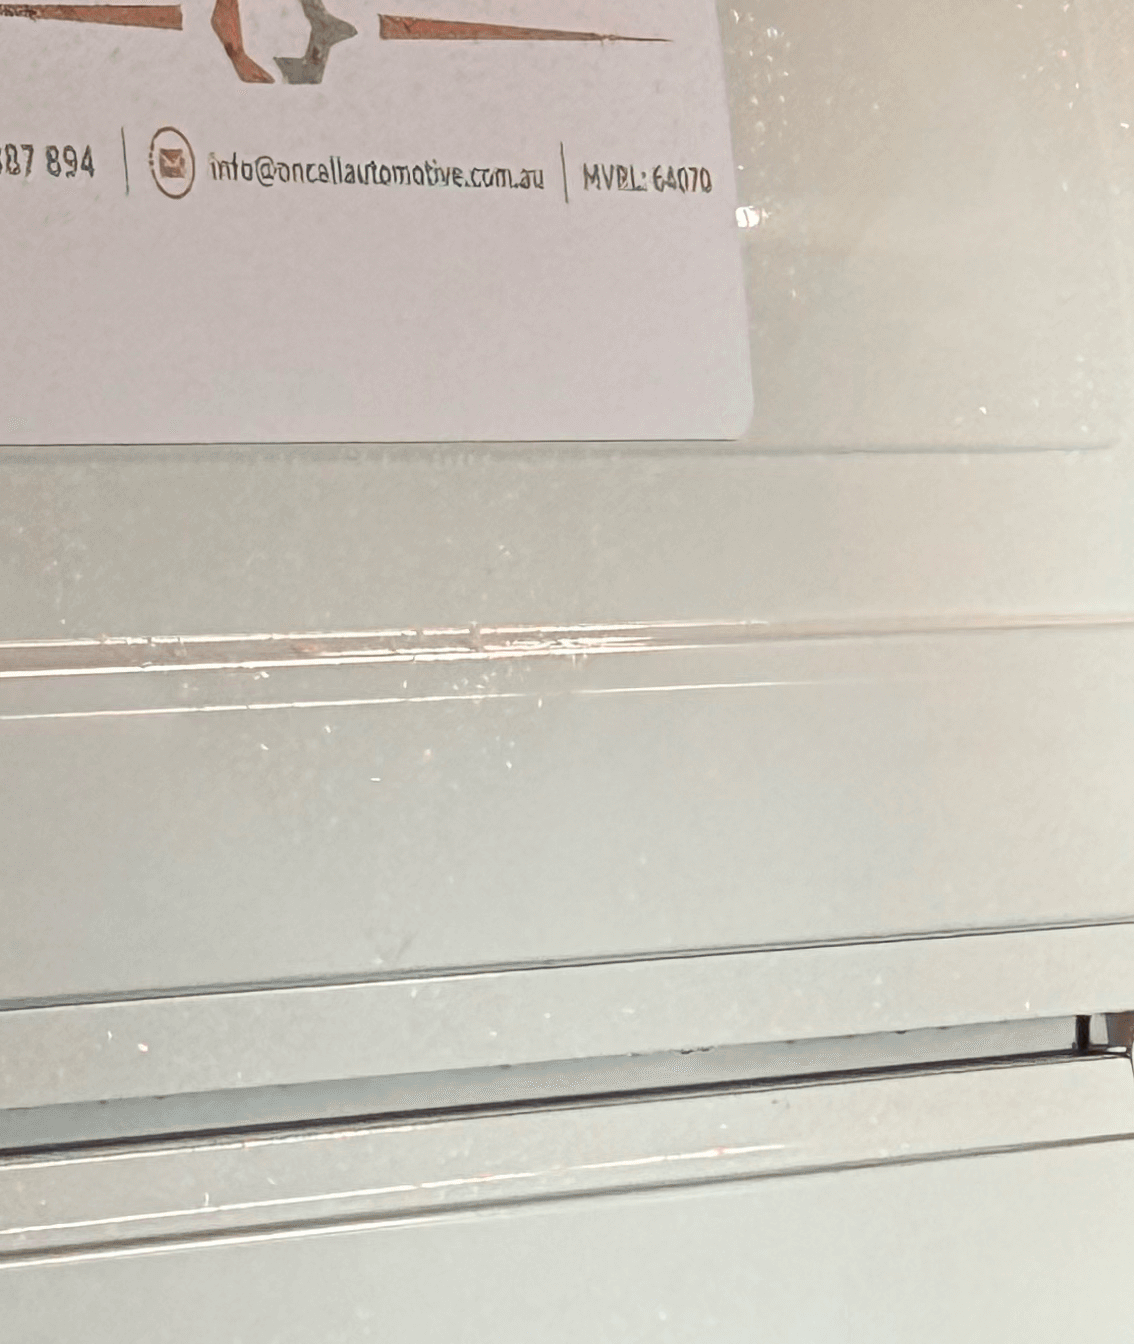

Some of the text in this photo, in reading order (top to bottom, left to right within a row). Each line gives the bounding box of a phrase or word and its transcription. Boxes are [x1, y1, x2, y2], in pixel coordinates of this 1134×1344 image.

[0, 142, 95, 178] 87 894
[208, 151, 544, 189] info@oncallautomotive.com.au
